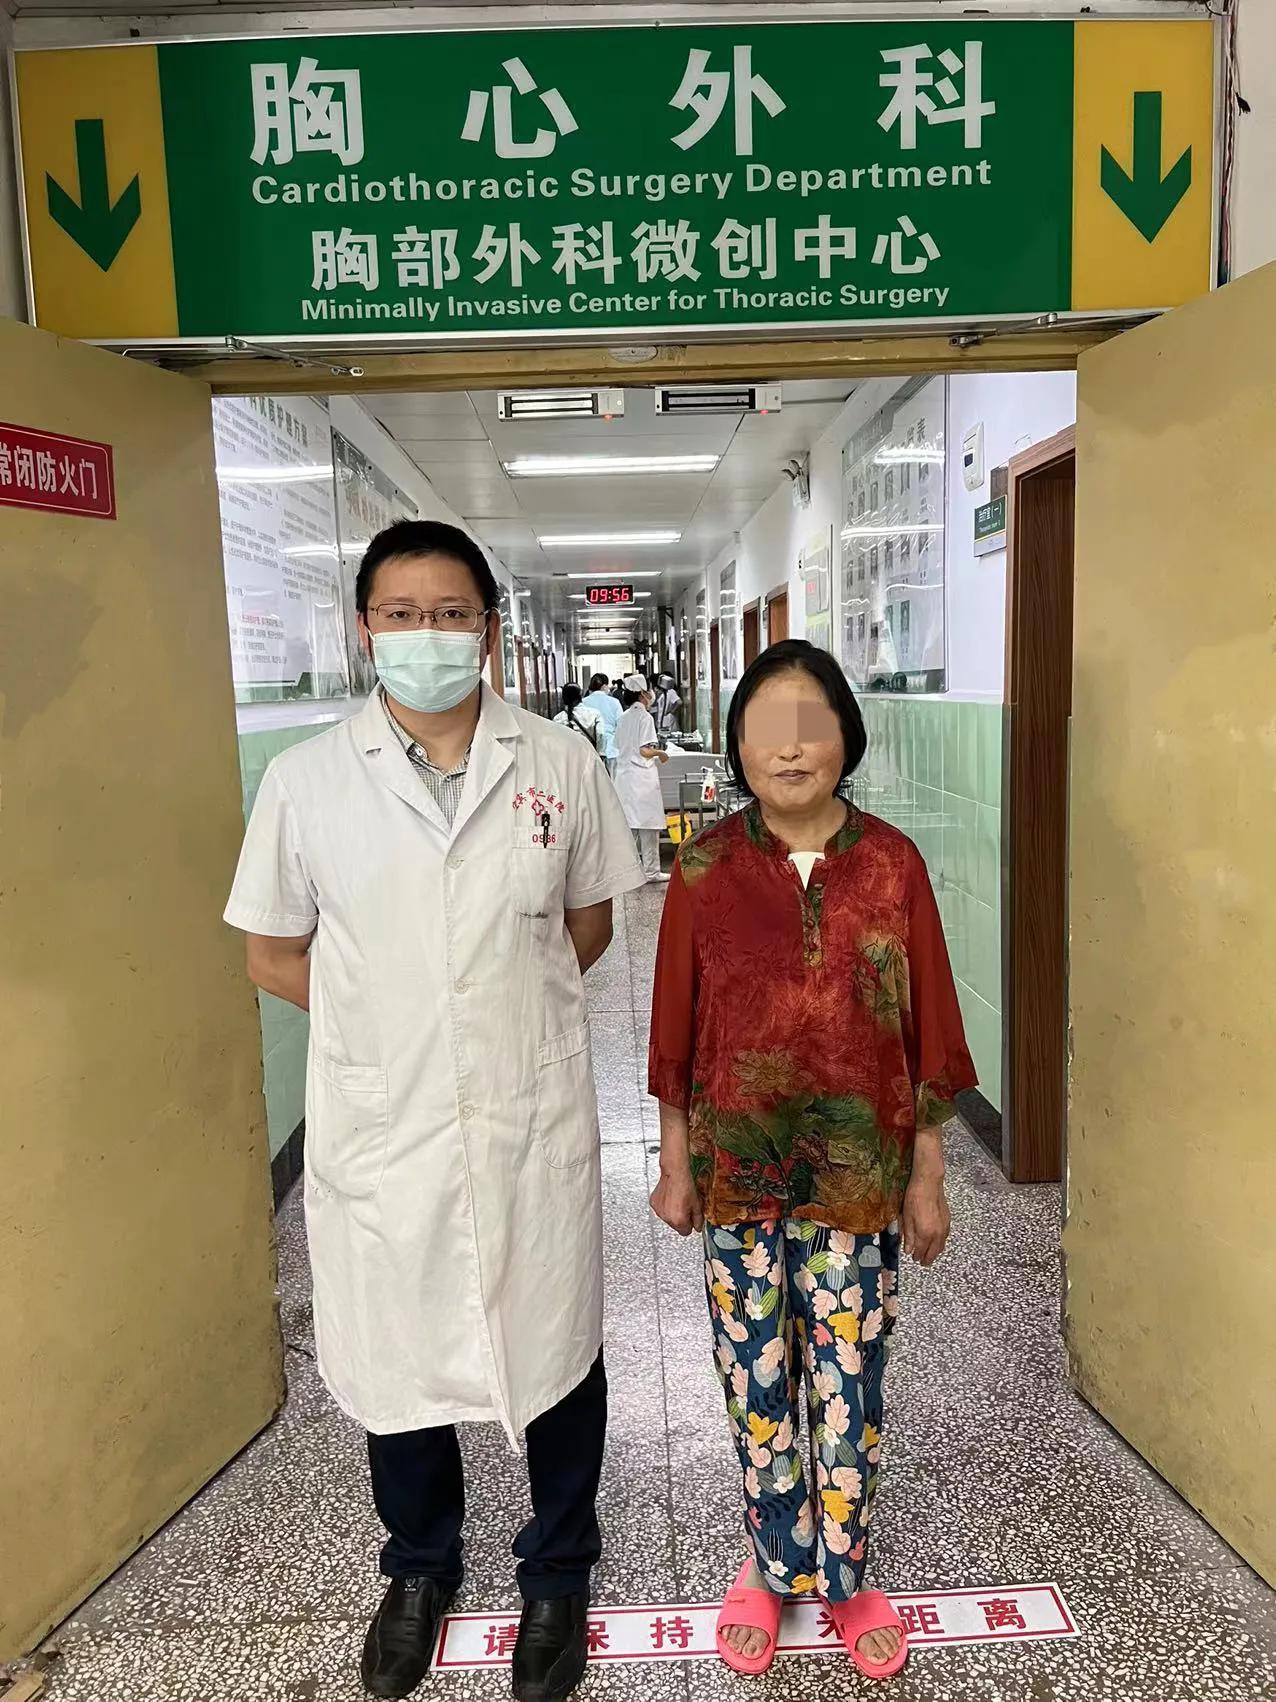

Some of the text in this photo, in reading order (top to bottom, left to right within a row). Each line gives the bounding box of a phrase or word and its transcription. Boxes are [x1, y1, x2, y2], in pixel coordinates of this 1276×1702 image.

[250, 41, 996, 165] 胸心外科
[252, 160, 992, 204] Cardiothoracic Surgery Department
[311, 214, 941, 291] 胸部外科微创中心
[301, 284, 950, 321] Minimally Invasive Center for Thoracic Surgery
[0, 441, 98, 499] 常闭防火门
[590, 587, 629, 602] 09:56
